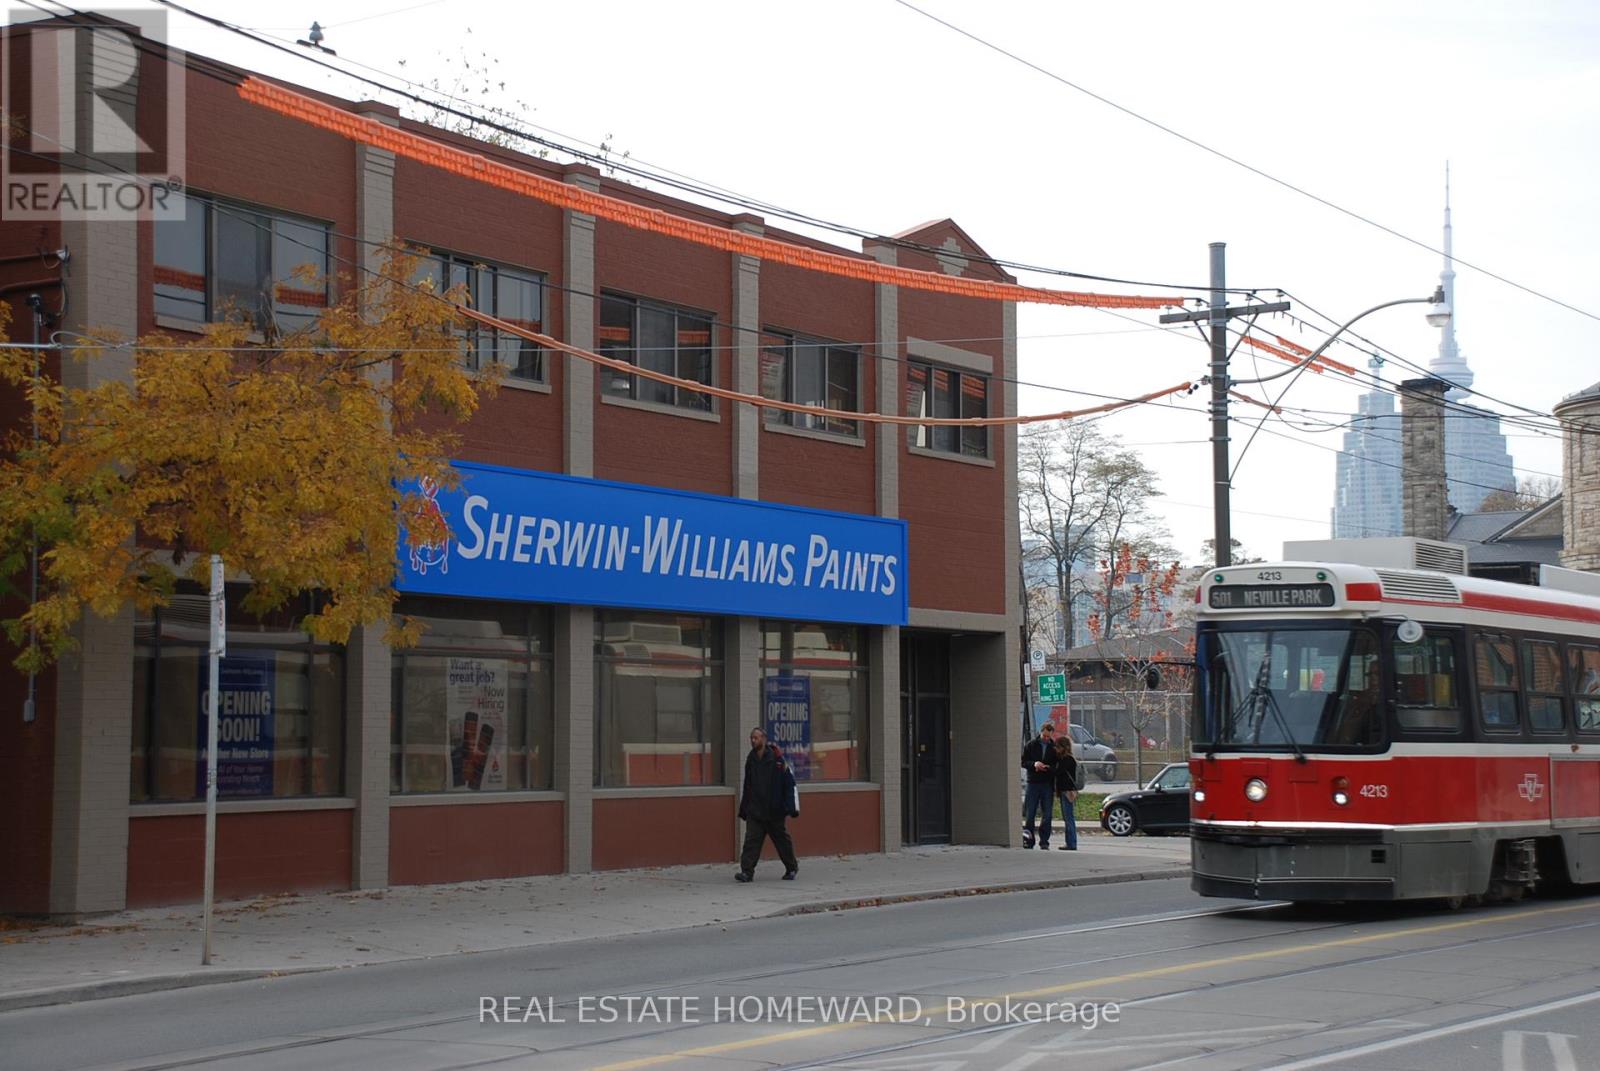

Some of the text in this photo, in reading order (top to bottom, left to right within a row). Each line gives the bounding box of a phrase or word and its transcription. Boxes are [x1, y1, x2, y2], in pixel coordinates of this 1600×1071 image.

[804, 534, 898, 596] PAINTS
[1257, 571, 1282, 581] 4213
[1212, 589, 1322, 607] 501 NEVILLE PARK
[450, 658, 473, 670] Want
[449, 671, 495, 686] great job?
[483, 686, 505, 697] Now
[477, 697, 505, 713] Hiring
[768, 702, 808, 721] OPENING
[774, 722, 802, 742] SOON!
[1360, 784, 1388, 798] 4213
